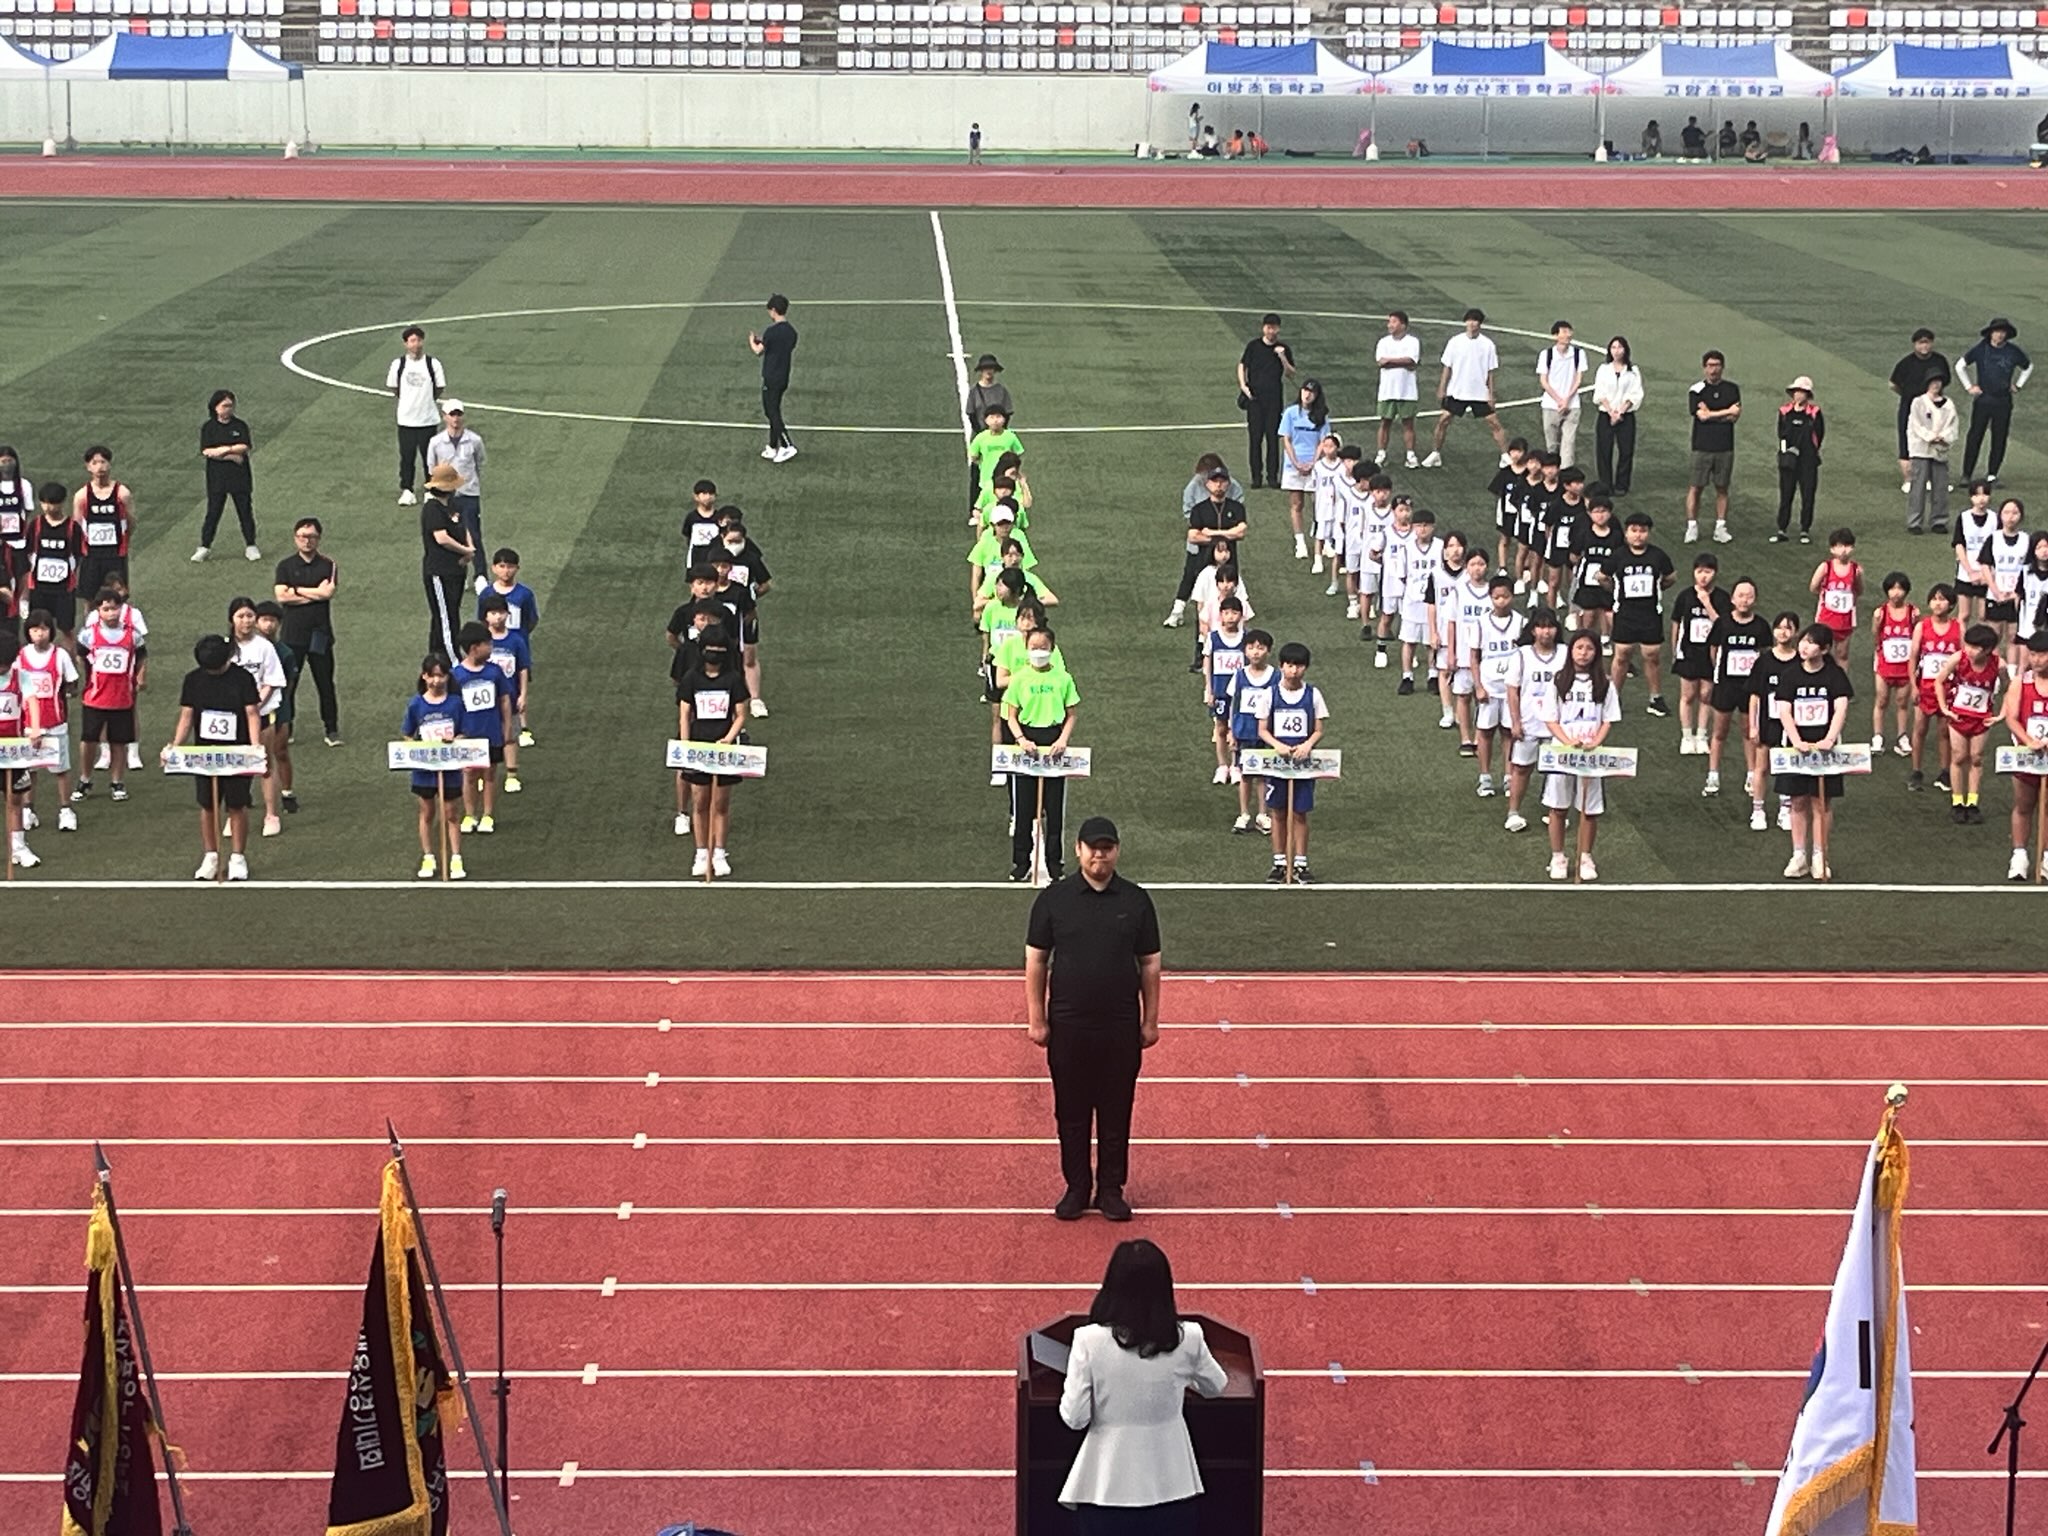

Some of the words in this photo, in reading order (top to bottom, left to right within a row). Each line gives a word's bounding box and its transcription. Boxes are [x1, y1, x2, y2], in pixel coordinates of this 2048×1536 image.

[1831, 595, 1847, 609] 31
[1890, 644, 1908, 659] 33
[102, 653, 122, 669] 65
[472, 688, 492, 706] 60
[1962, 692, 1983, 709] 32
[699, 698, 728, 714] 154
[1797, 704, 1825, 721] 137
[208, 718, 229, 735] 63
[1282, 716, 1303, 733] 48
